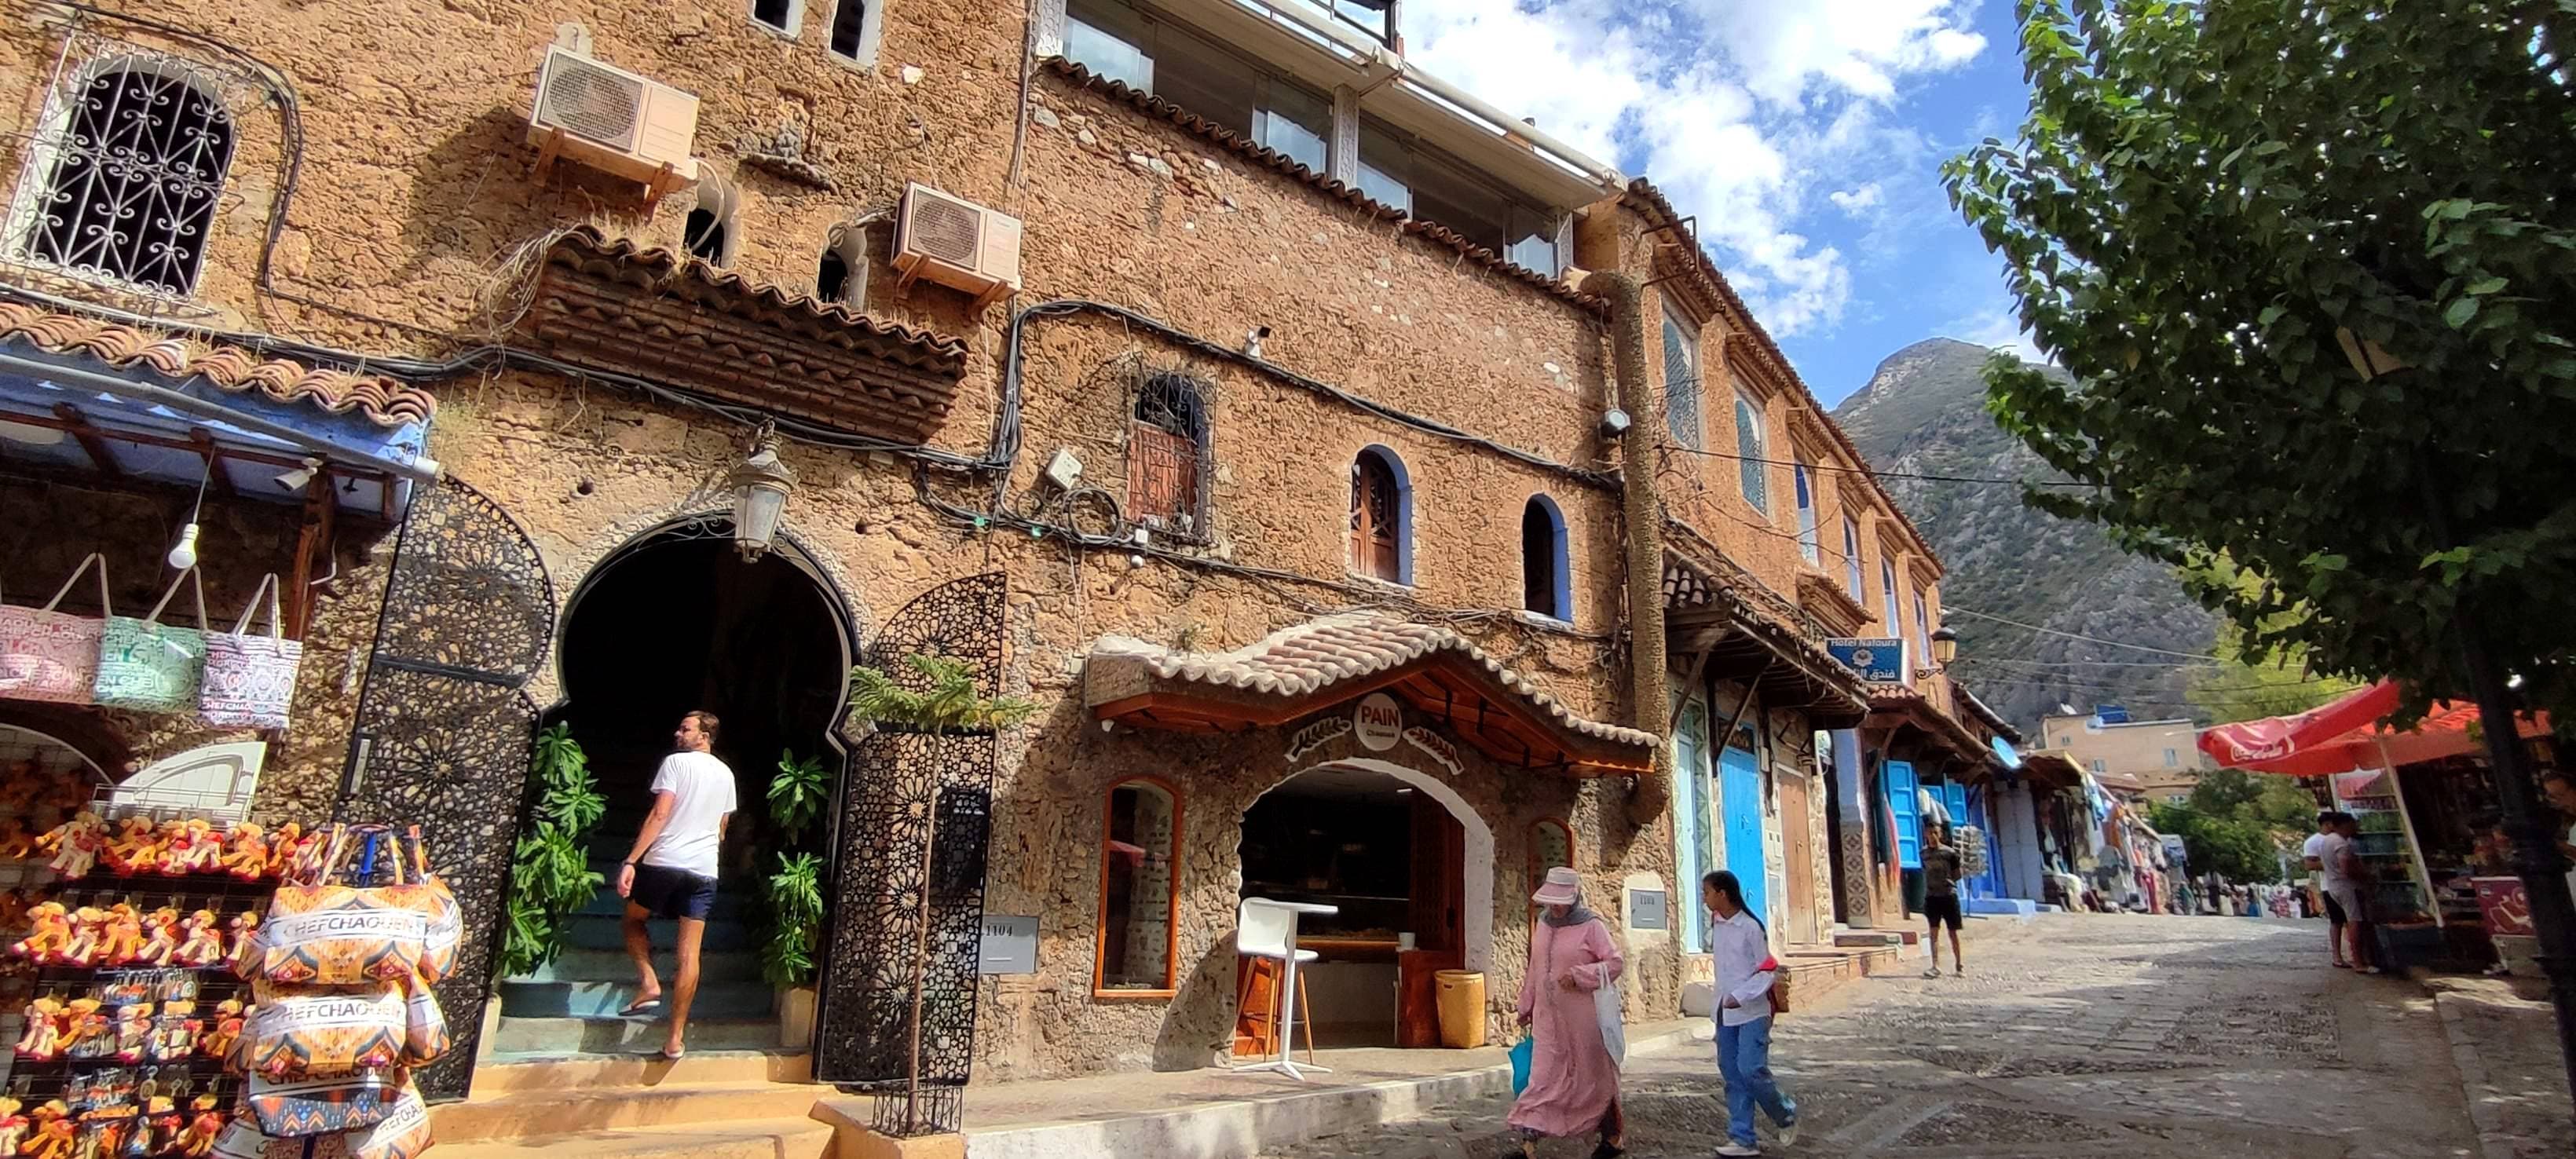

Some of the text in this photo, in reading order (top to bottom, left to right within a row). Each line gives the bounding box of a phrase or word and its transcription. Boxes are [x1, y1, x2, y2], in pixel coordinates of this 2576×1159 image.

[1870, 668, 1896, 681] فندق
[1361, 706, 1399, 728] PAIN
[284, 916, 415, 937] CHEFCHAOUEN
[986, 925, 1012, 937] 1104
[280, 1002, 401, 1022] HEFCHAOUEN
